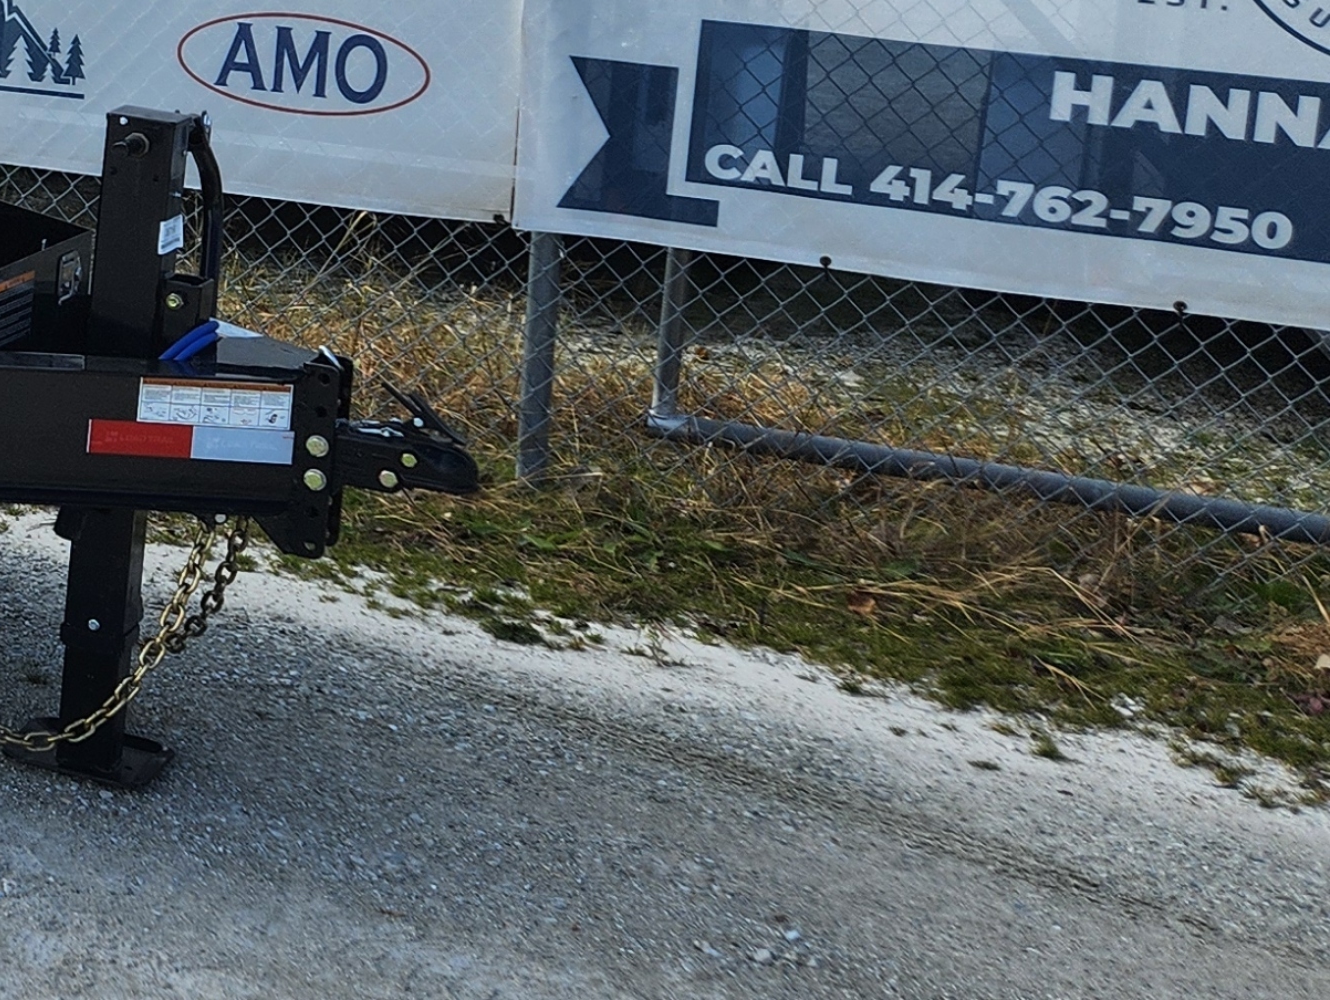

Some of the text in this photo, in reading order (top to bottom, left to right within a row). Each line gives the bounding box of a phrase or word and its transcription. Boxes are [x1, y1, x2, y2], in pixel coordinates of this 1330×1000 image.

[213, 21, 388, 104] AMO
[704, 143, 1294, 250] CALL 414-762-7950
